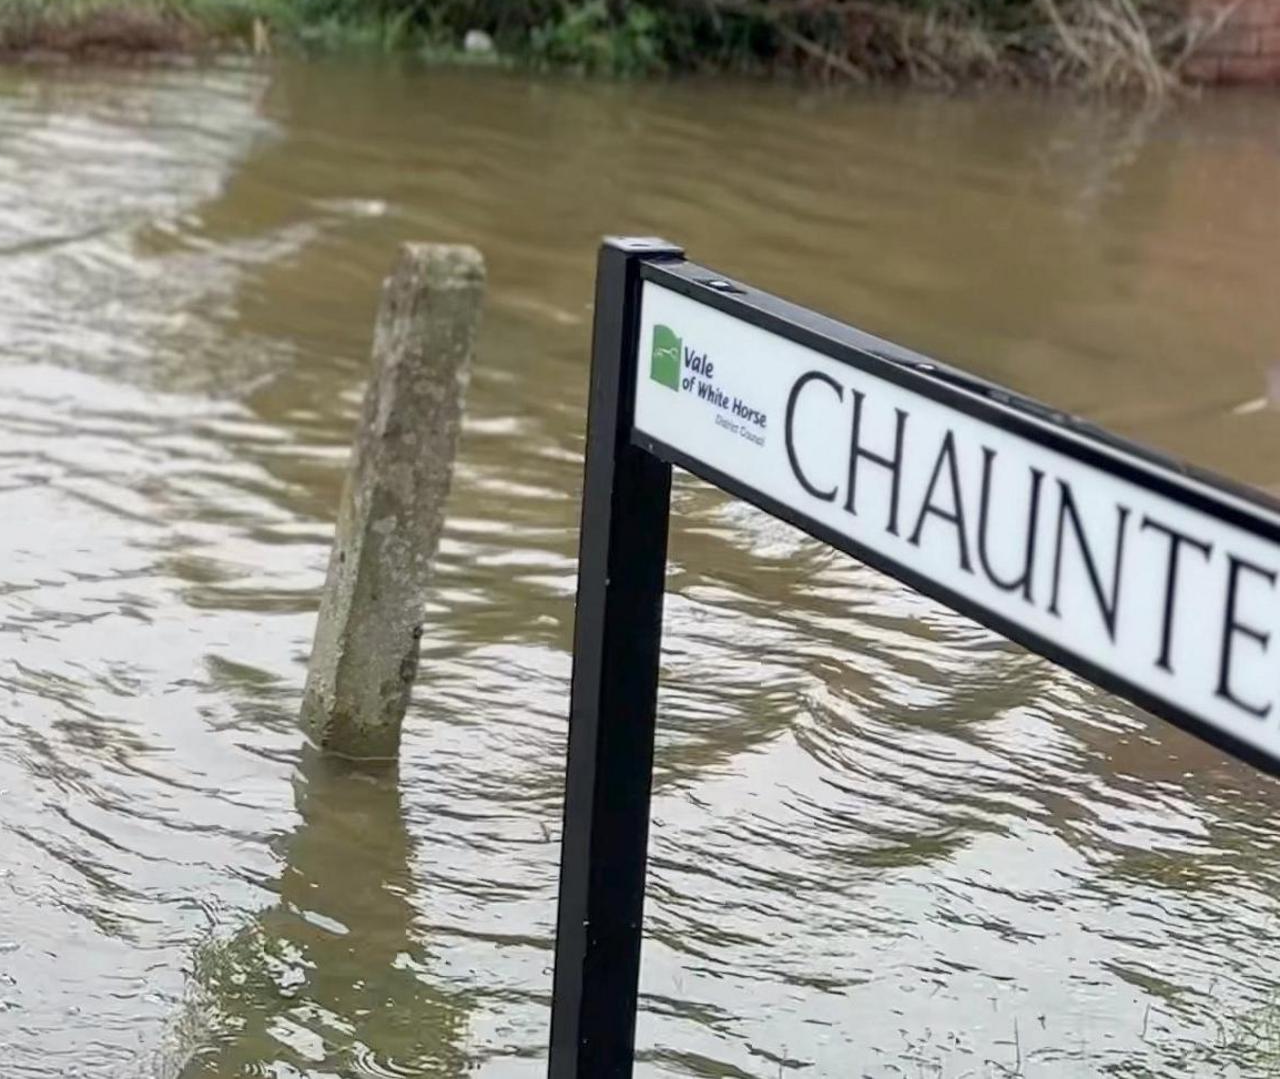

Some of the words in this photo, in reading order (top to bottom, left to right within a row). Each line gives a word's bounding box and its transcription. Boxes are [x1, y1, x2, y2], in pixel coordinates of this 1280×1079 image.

[684, 347, 714, 378] Vale
[682, 377, 696, 392] of
[698, 381, 729, 409] White
[732, 398, 767, 428] Horse
[785, 370, 1280, 723] CHAUNTE
